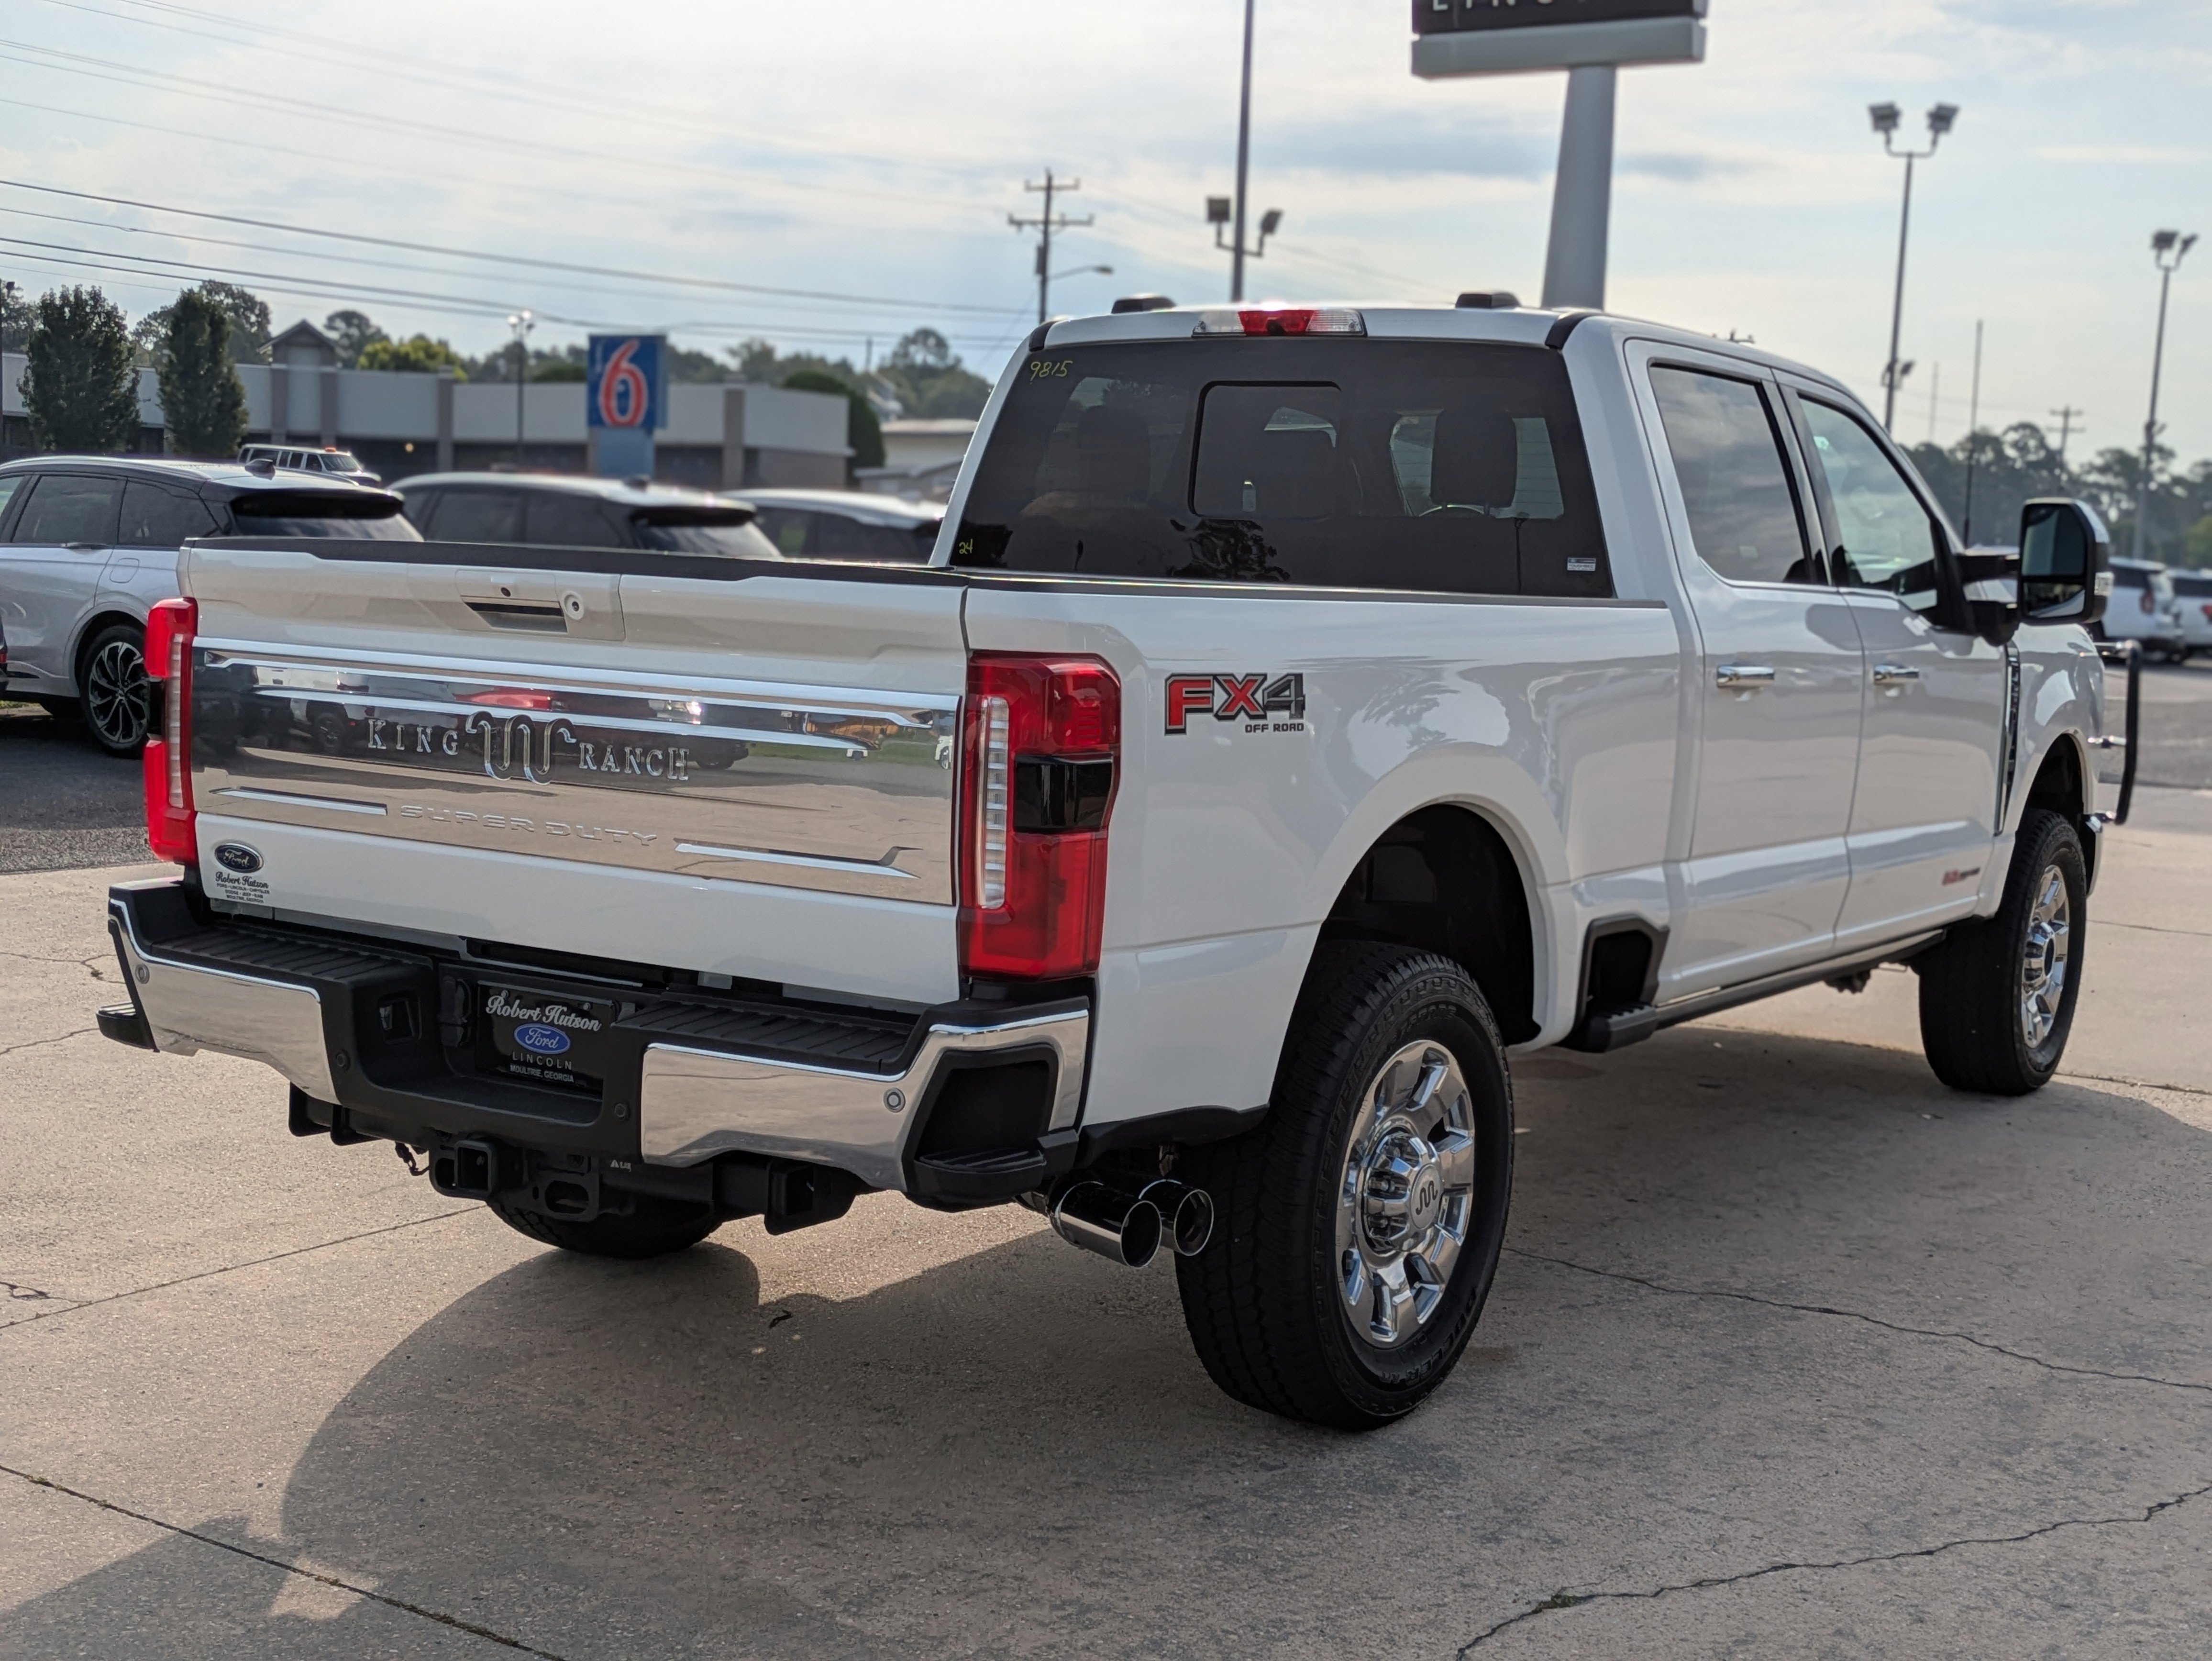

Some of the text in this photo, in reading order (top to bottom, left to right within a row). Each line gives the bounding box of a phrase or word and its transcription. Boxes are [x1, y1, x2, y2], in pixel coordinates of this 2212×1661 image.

[1030, 360, 1073, 382] 9815
[598, 338, 647, 427] 6
[959, 538, 973, 554] 24
[1164, 673, 1306, 735] FX4
[1245, 723, 1305, 733] OFF ROAD
[367, 719, 690, 781] KING RANCH
[401, 805, 657, 846] SUPER DUTY
[223, 849, 250, 868] Ford
[216, 871, 269, 889] Robert Hutson
[486, 995, 602, 1031] Robert Hutson
[525, 1028, 559, 1049] Ford
[512, 1051, 572, 1070] LINCOLN
[544, 1071, 574, 1083] GEORGIA
